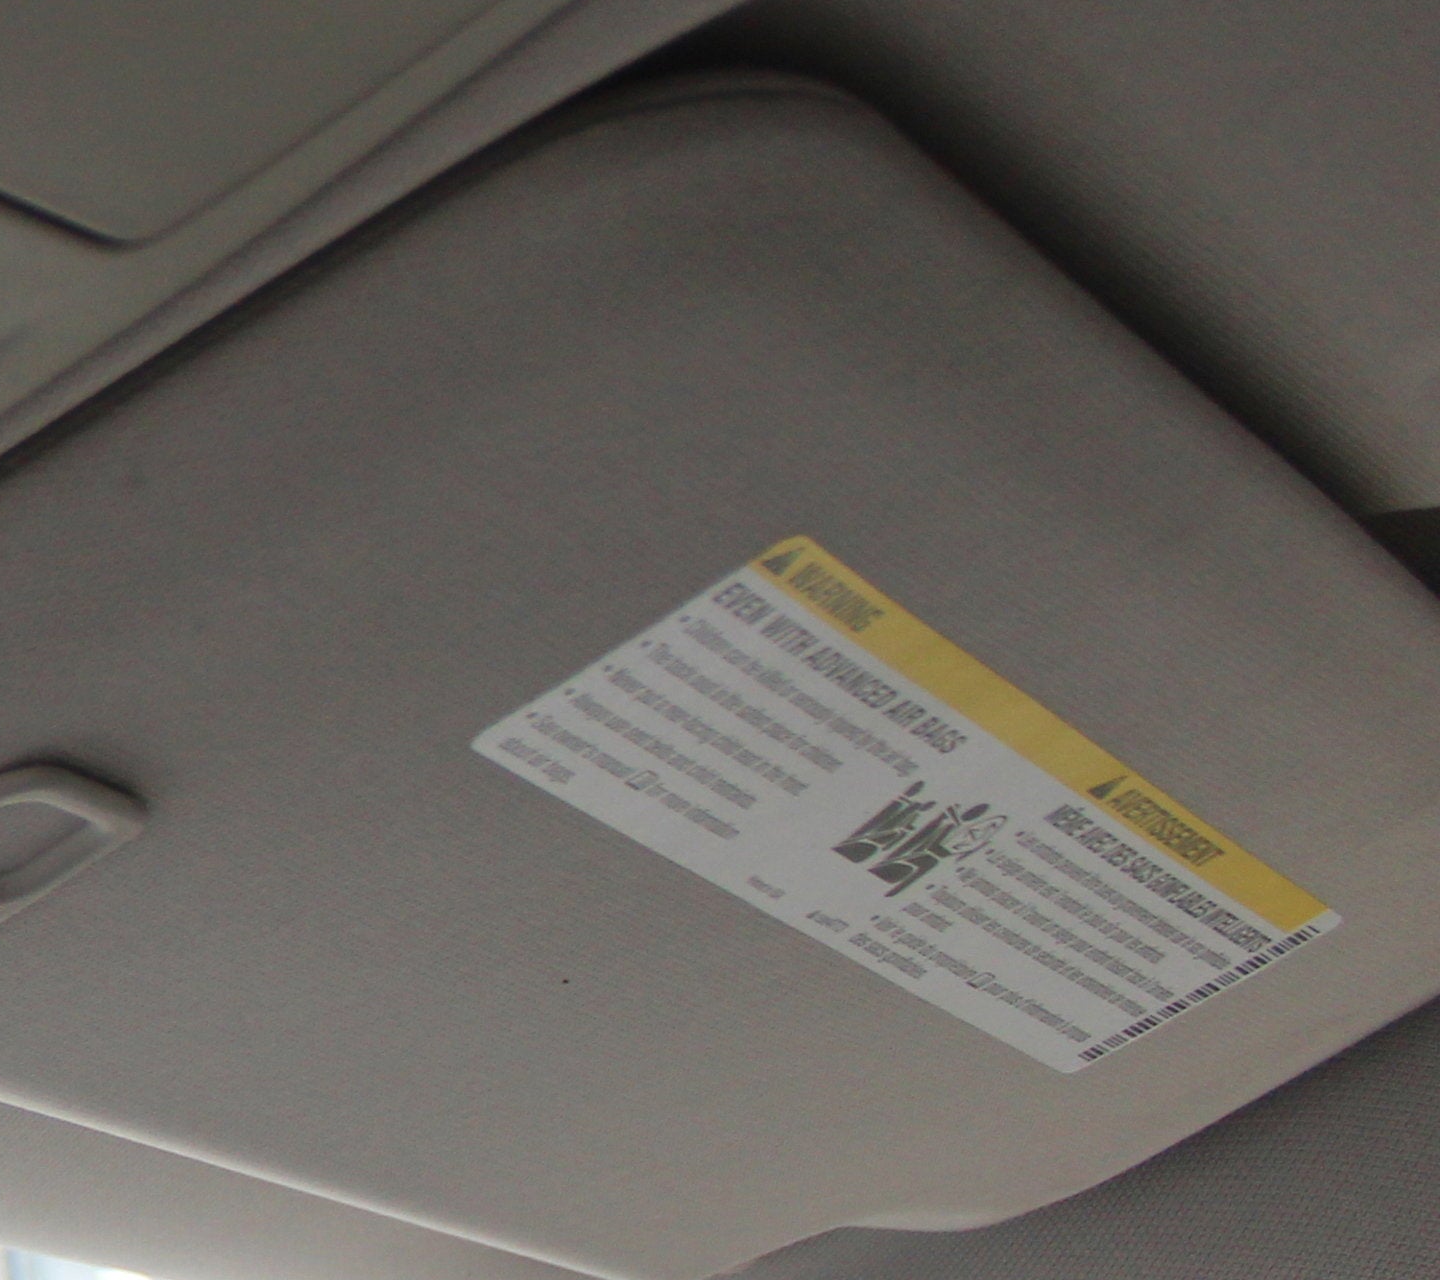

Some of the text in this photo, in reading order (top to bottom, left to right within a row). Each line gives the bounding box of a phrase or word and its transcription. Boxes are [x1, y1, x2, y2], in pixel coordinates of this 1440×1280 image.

[783, 561, 888, 633] WARNING
[708, 581, 971, 756] EVEN WITH ADVANCED AIR BAGS
[1099, 841, 1141, 867] DES
[1104, 787, 1226, 869] AVERTISSEMENT
[1119, 854, 1167, 883] SACS
